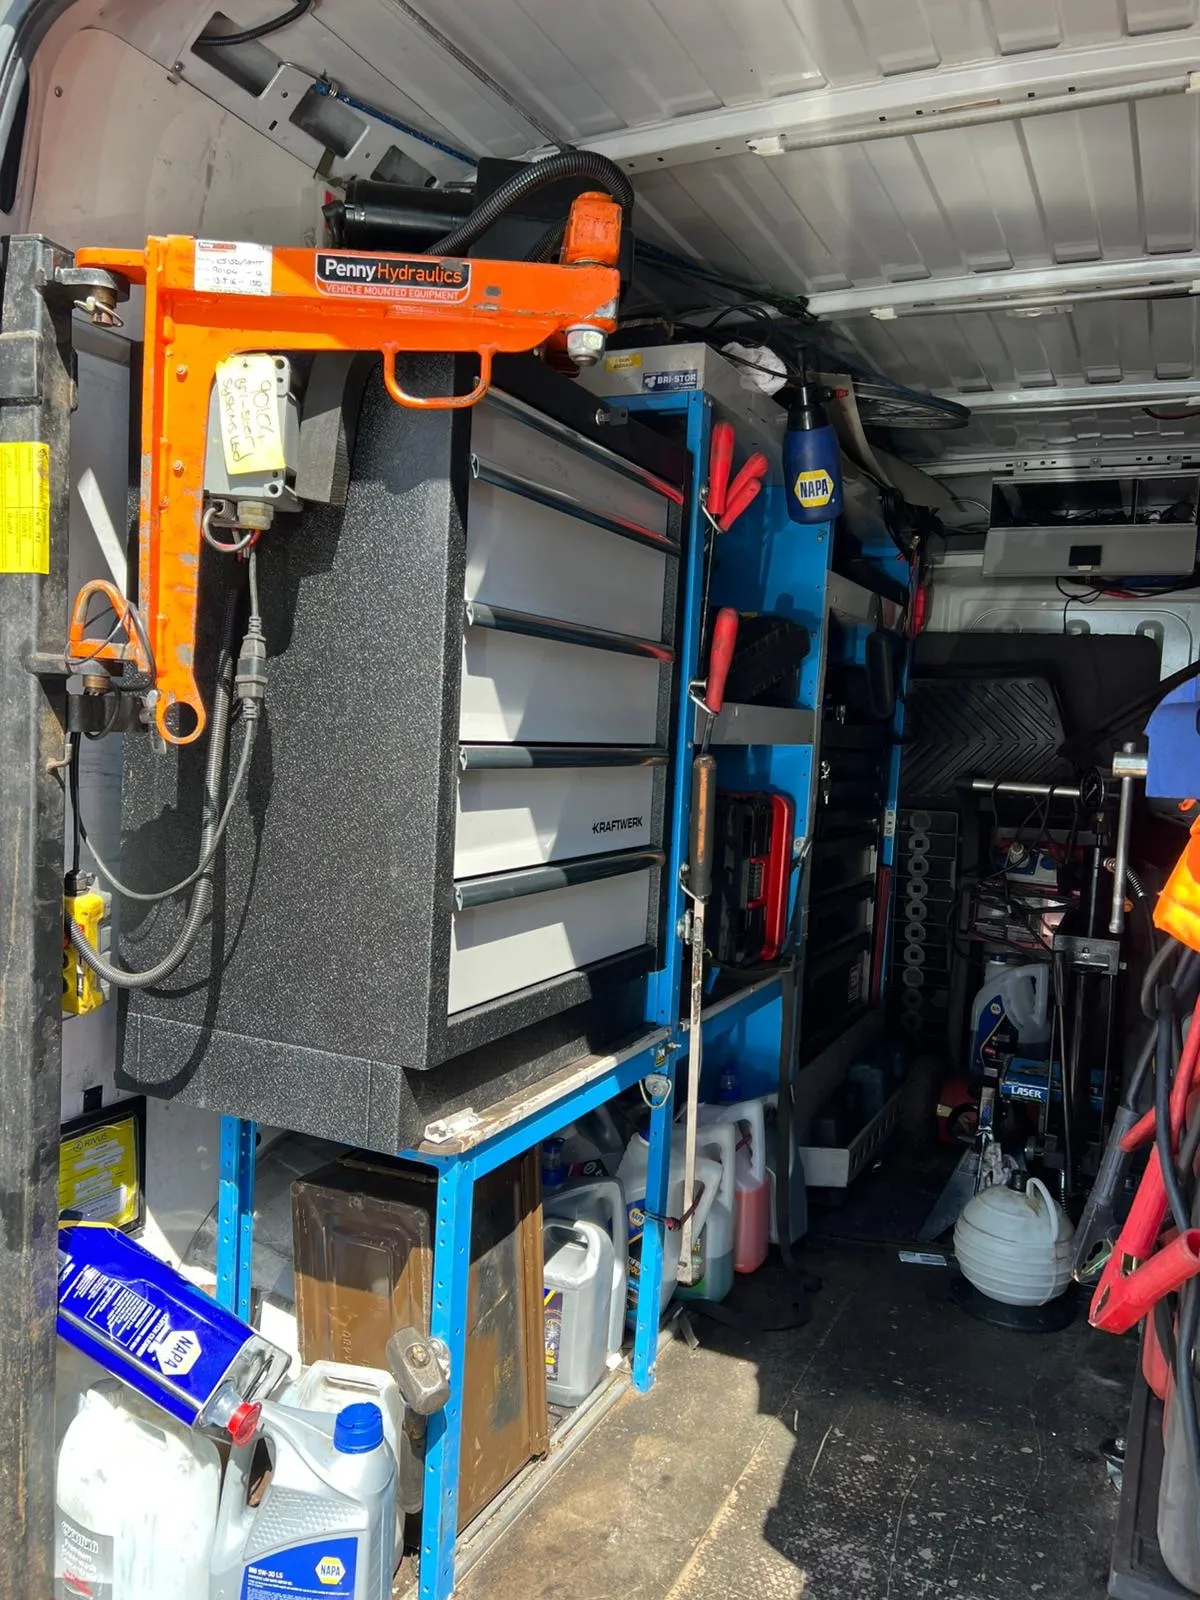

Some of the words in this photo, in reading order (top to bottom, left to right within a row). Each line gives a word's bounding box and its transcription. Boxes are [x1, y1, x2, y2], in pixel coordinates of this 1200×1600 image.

[325, 258, 376, 282] Penny
[377, 262, 462, 283] Hydraulics
[325, 284, 361, 295] VEHICLE
[364, 286, 407, 297] MOUNTED
[409, 289, 459, 300] EQUIPMENT
[657, 373, 696, 384] BRI-STOR
[800, 479, 829, 498] NAPA
[592, 816, 643, 834] KRAFTWERK
[1010, 1085, 1041, 1098] LASER
[164, 1335, 194, 1369] NAPA
[320, 1563, 341, 1577] NAPA
